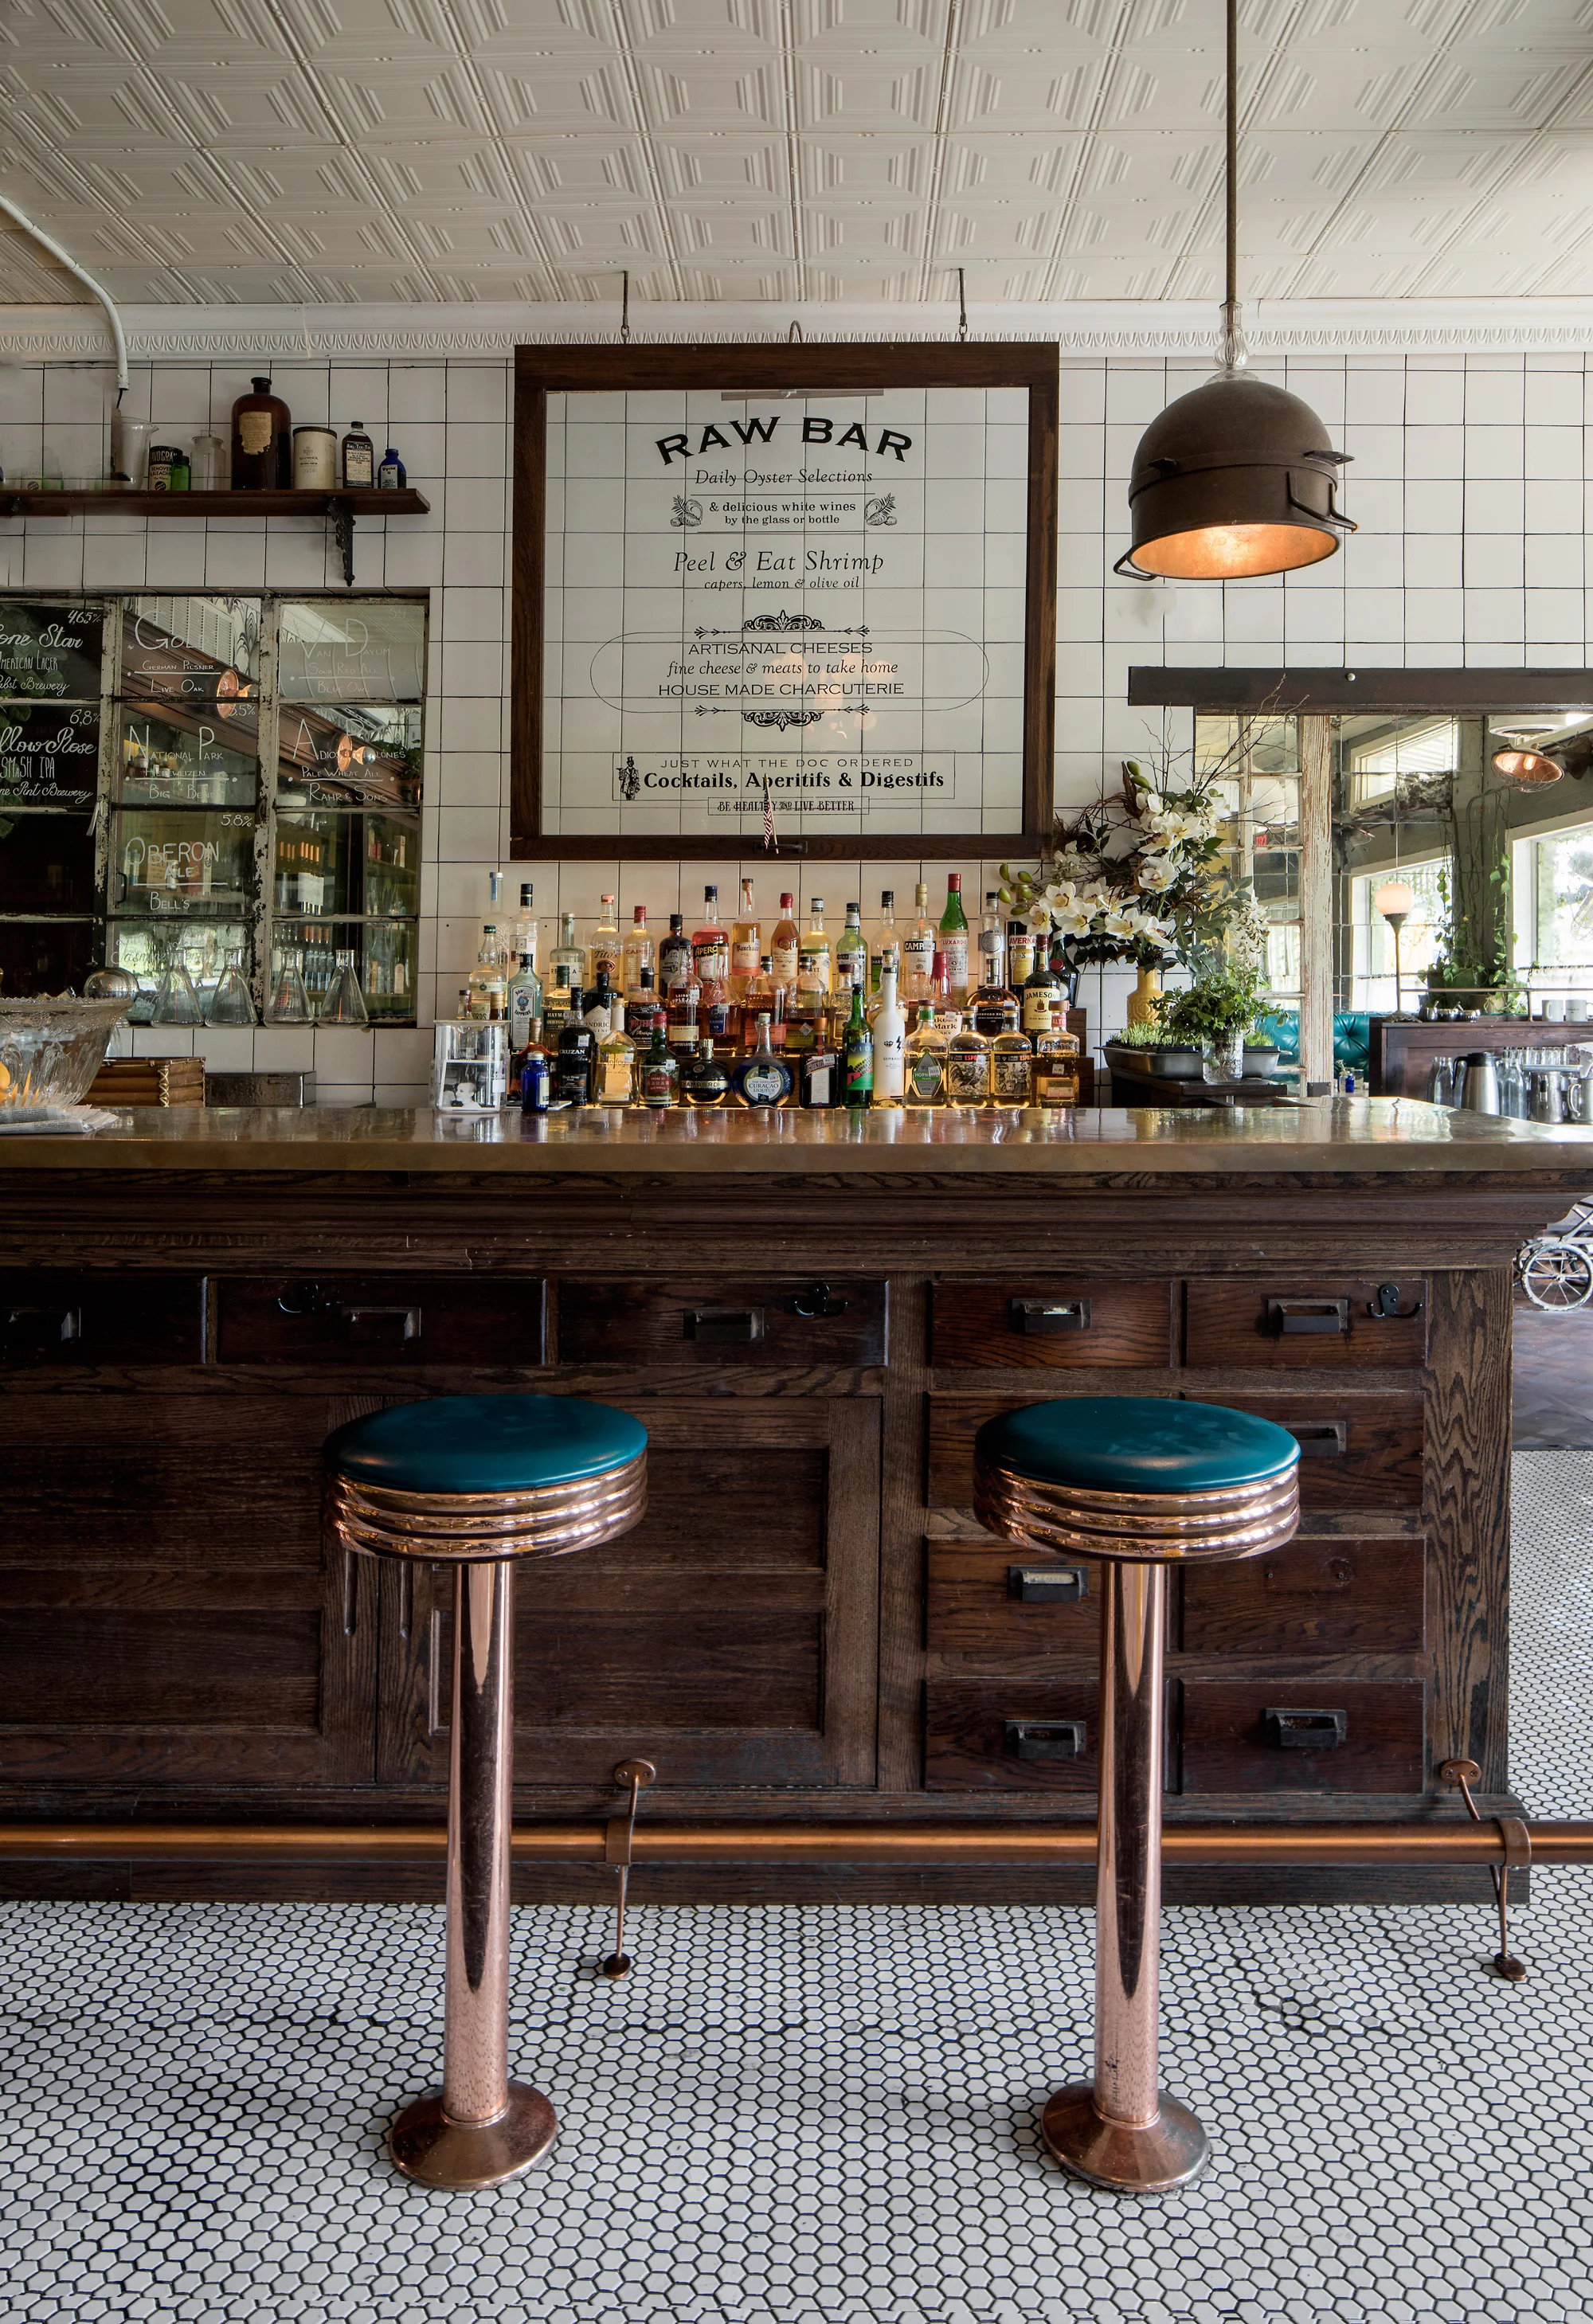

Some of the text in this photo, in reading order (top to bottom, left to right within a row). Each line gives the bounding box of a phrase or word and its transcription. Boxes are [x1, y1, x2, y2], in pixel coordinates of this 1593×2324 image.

[655, 417, 912, 465] RAW BAR
[695, 468, 873, 487] Daily Oyster Selections
[709, 502, 856, 512] & delicious white wines
[725, 515, 738, 526] by
[742, 515, 759, 524] the
[762, 515, 790, 526] glass
[808, 514, 840, 524] bottle
[674, 550, 884, 574] Peel & Eat Shrimp
[704, 576, 859, 591] capers, lemon & olive oil
[38, 623, 84, 648] Star
[688, 642, 873, 655] ARTISANAL CHEESES
[667, 659, 898, 677] fine cheese & meats to take home
[21, 676, 71, 697] Brewery
[658, 683, 904, 696] HOUSE MADE CHARCUTERIE
[0, 726, 97, 754] llow Rose
[39, 756, 55, 779] IPA
[660, 758, 913, 768] JUST WHAT THE DOC ORDERED
[644, 771, 944, 790] Cocktails, Aperitifs & Digestifs
[13, 781, 41, 796] Pint
[41, 782, 94, 804] Brewery
[717, 801, 731, 812] BE
[733, 801, 777, 812] HEALTY
[794, 801, 815, 811] LIVE
[817, 800, 855, 811] BETTER
[221, 814, 252, 827] 5.8%
[695, 945, 718, 957] APERO
[905, 941, 936, 951] CAMPI
[594, 949, 619, 959] Tito's
